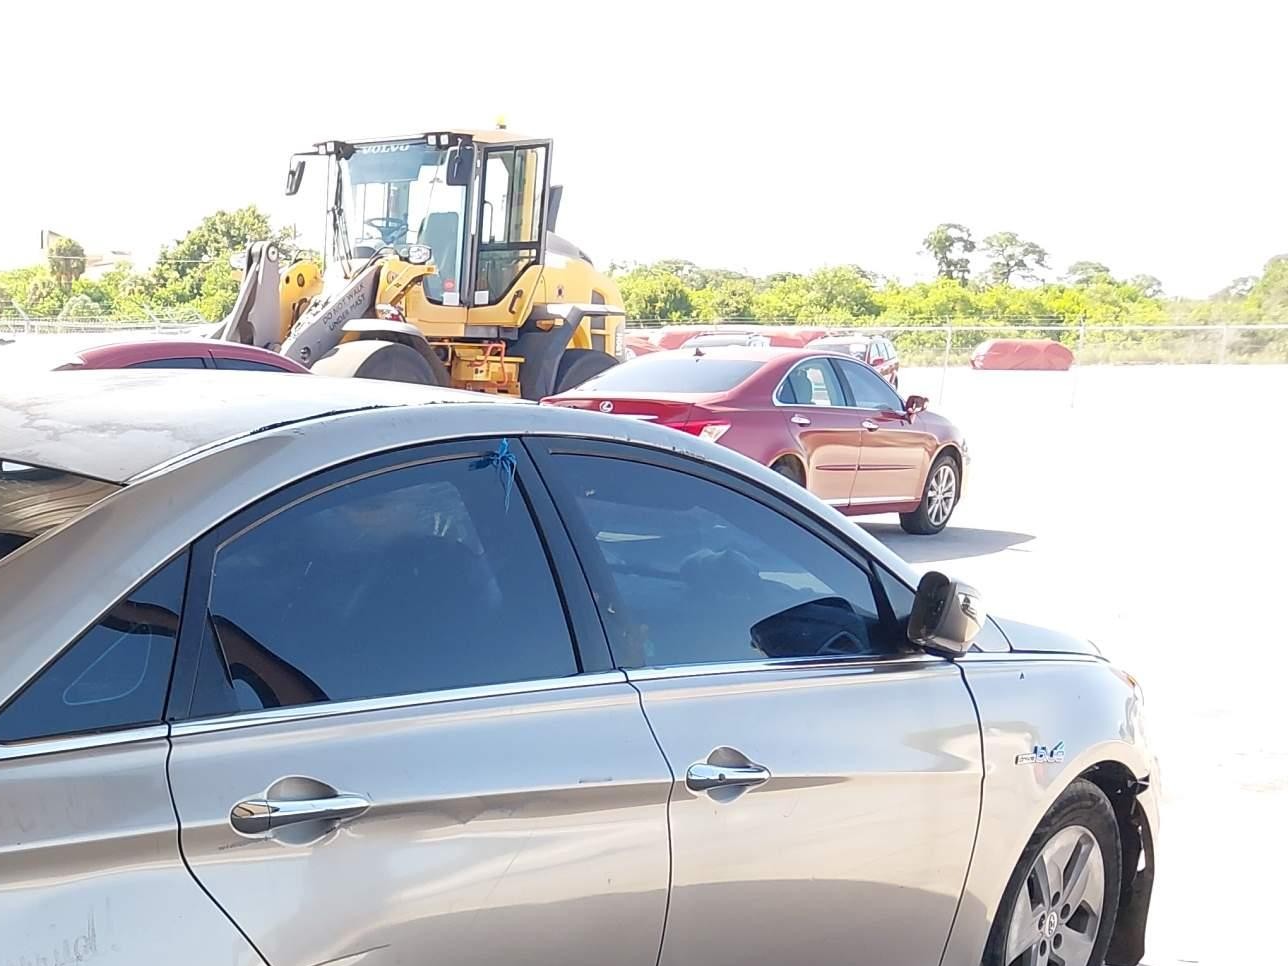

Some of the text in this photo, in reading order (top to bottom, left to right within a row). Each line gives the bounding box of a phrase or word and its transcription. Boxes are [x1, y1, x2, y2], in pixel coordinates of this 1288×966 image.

[362, 143, 410, 154] VOLVO
[322, 312, 333, 325] DO
[346, 282, 365, 301] WALK
[328, 294, 366, 331] UNDER MAST
